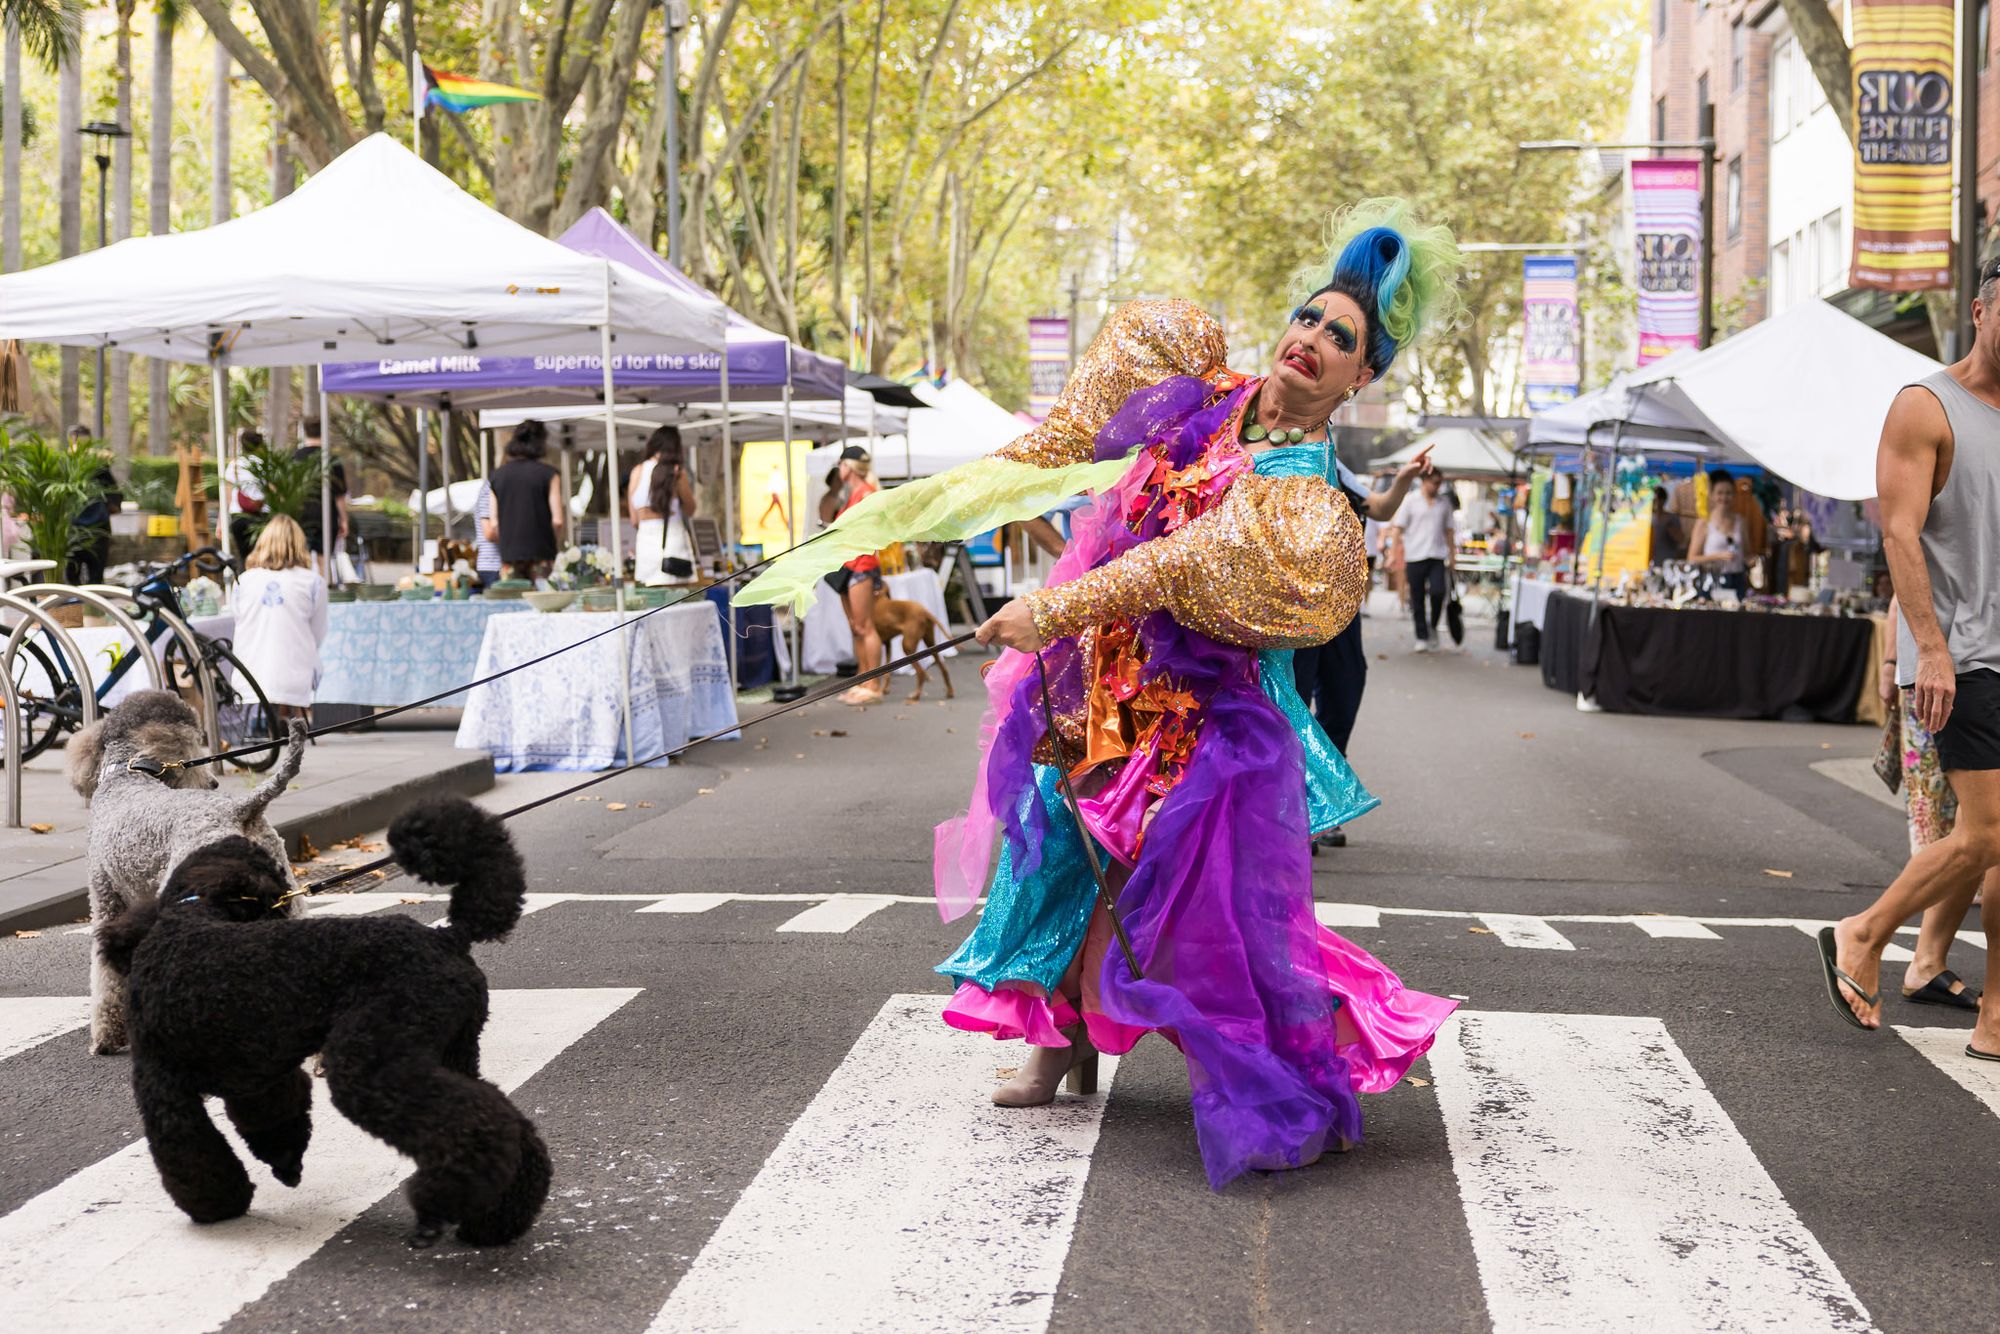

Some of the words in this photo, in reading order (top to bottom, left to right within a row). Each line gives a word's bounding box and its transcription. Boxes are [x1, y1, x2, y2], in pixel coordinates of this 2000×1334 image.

[379, 357, 437, 375] Camel
[440, 355, 482, 373] Milk
[533, 354, 623, 374] superfod
[626, 354, 653, 370] for
[655, 354, 685, 370] the
